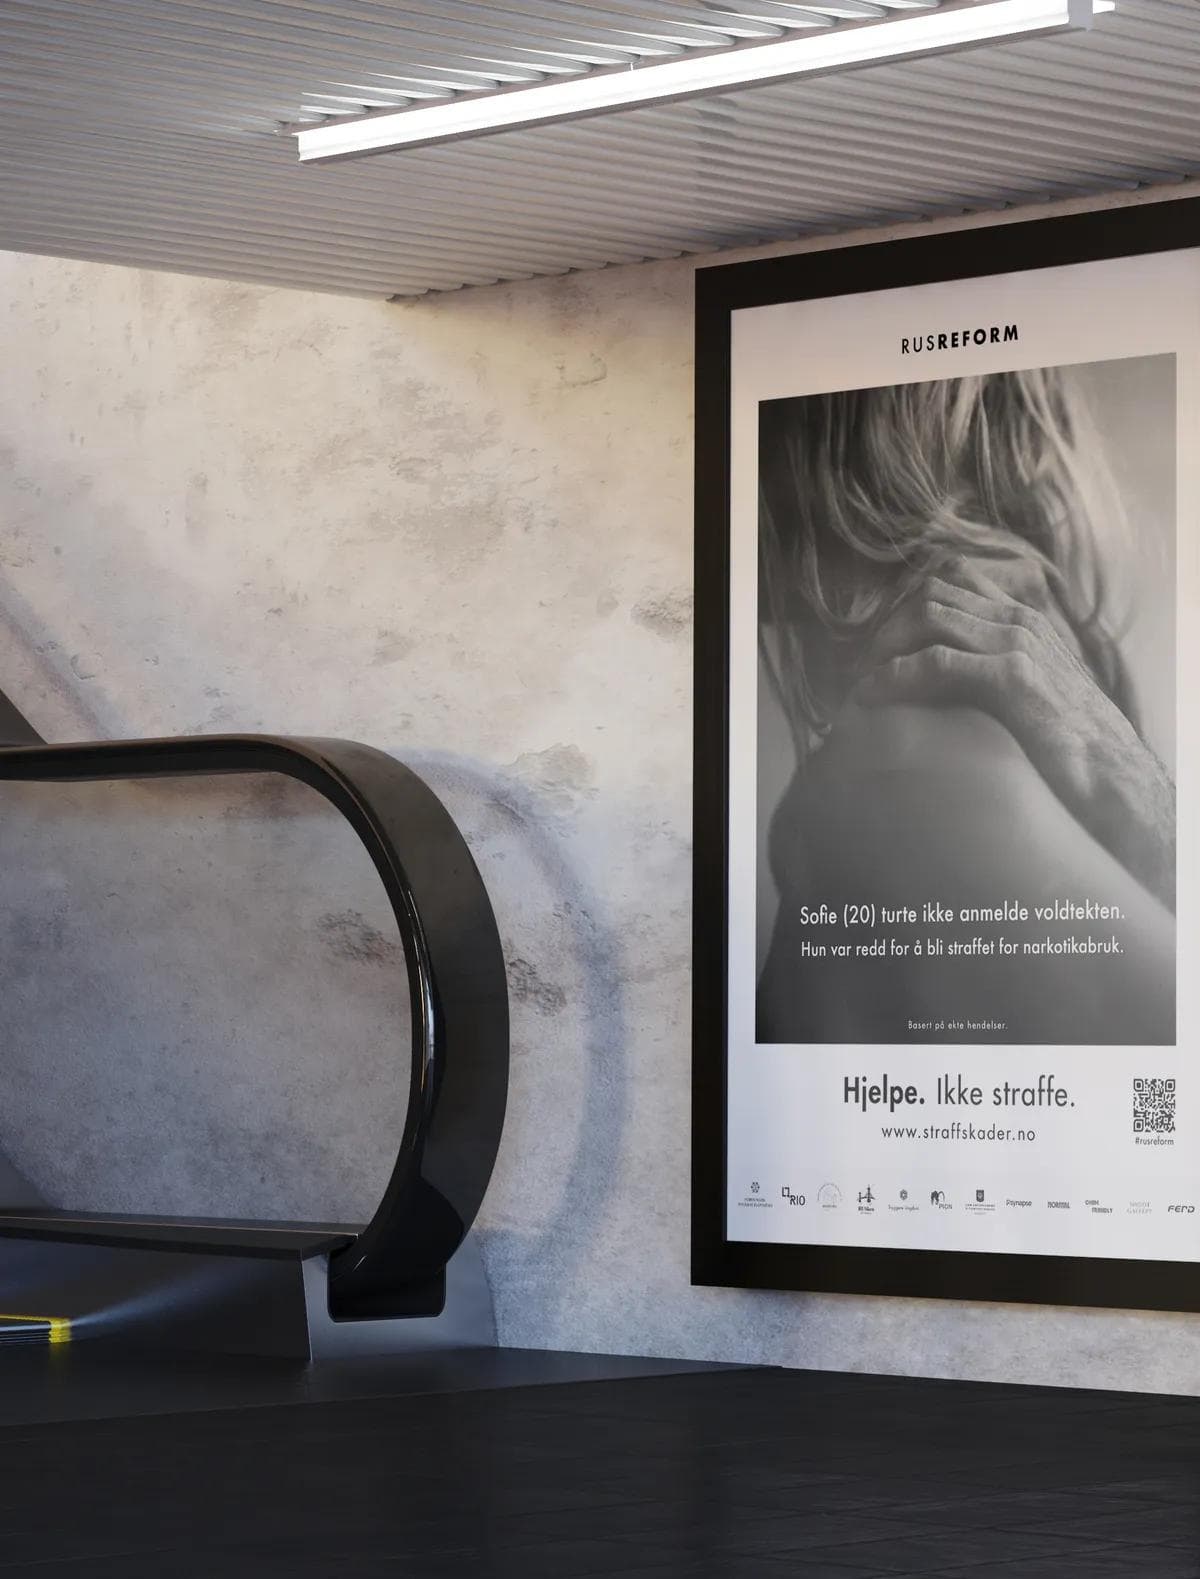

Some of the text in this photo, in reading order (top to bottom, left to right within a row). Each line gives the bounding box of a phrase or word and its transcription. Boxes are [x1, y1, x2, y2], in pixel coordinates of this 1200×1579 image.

[901, 324, 1019, 355] RUSREFORM
[800, 898, 1125, 928] Sofie (20) turte ikke anmelde voldtekten.
[800, 935, 1124, 957] Hun var redd for å bli straffet for narkotikabruk.
[907, 1019, 1008, 1032] Basert på ekte hendelser.
[844, 1073, 1075, 1113] Hjelpe. Ikke straffe.
[881, 1122, 1036, 1142] www.straffskader.no
[1134, 1136, 1176, 1147] #rusreform
[789, 1194, 807, 1207] RIO
